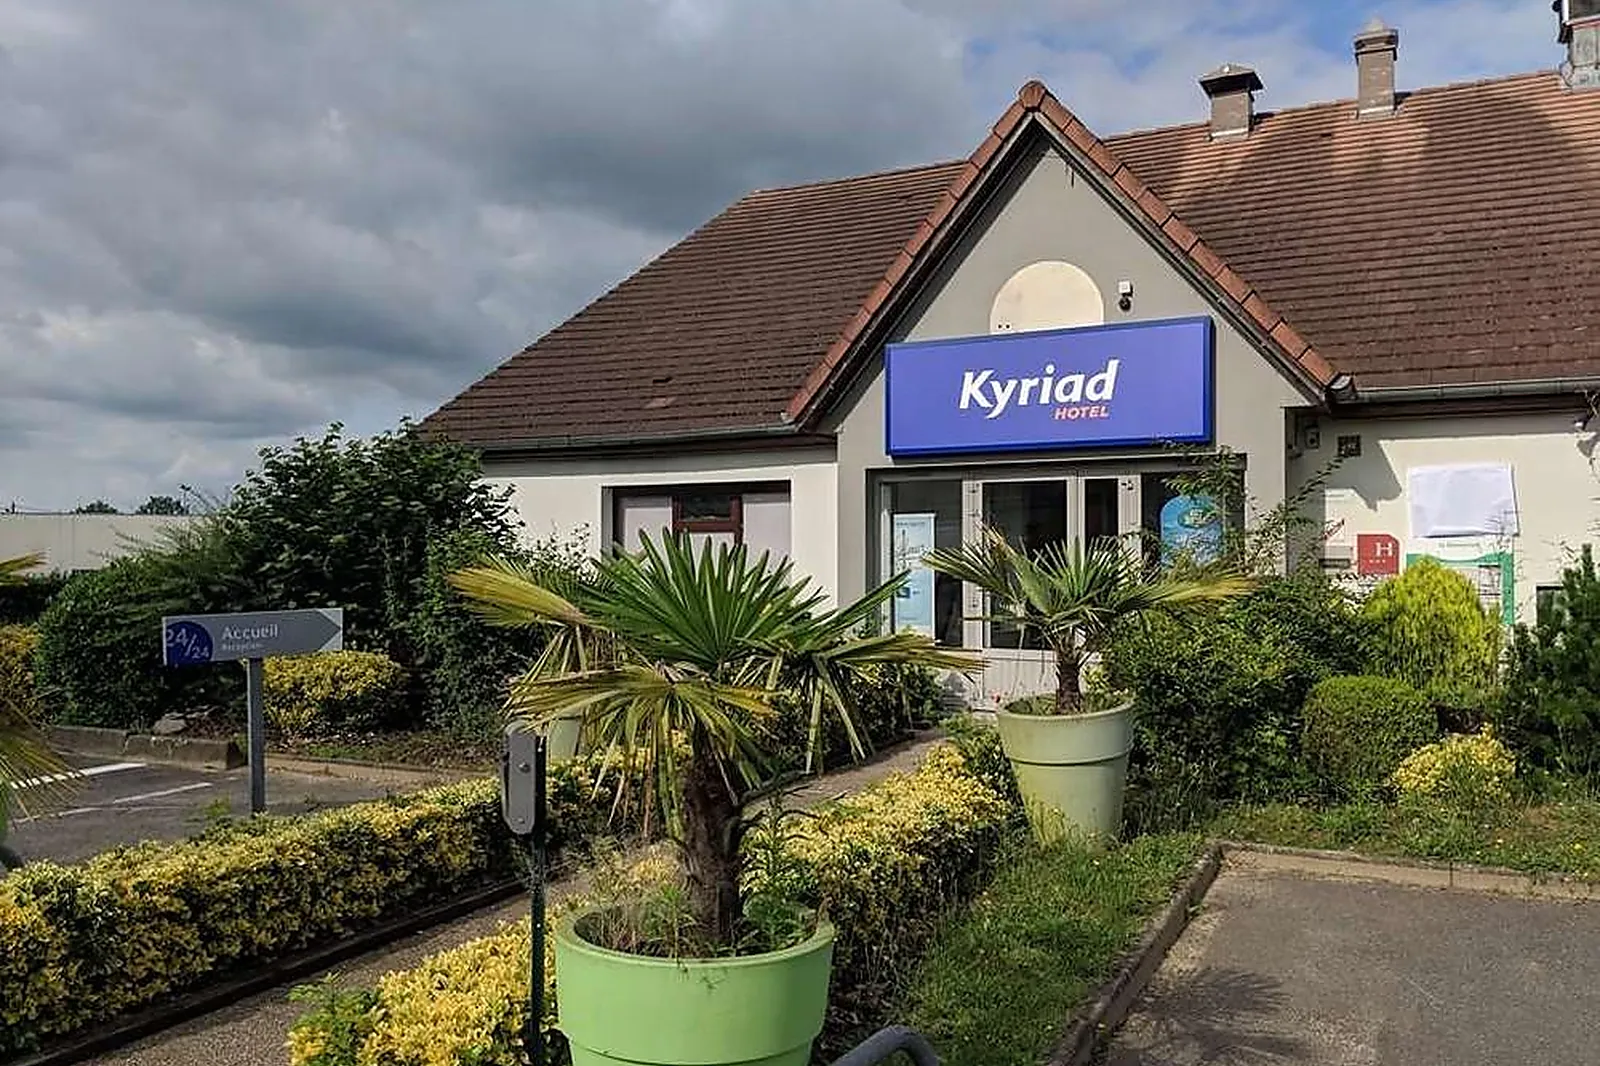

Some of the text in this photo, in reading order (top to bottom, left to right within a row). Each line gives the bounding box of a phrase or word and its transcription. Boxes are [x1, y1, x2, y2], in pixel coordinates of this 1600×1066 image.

[959, 359, 1120, 419] Kyriad
[1054, 405, 1110, 420] HOTEL
[1375, 541, 1394, 558] H
[222, 623, 279, 640] Accueil
